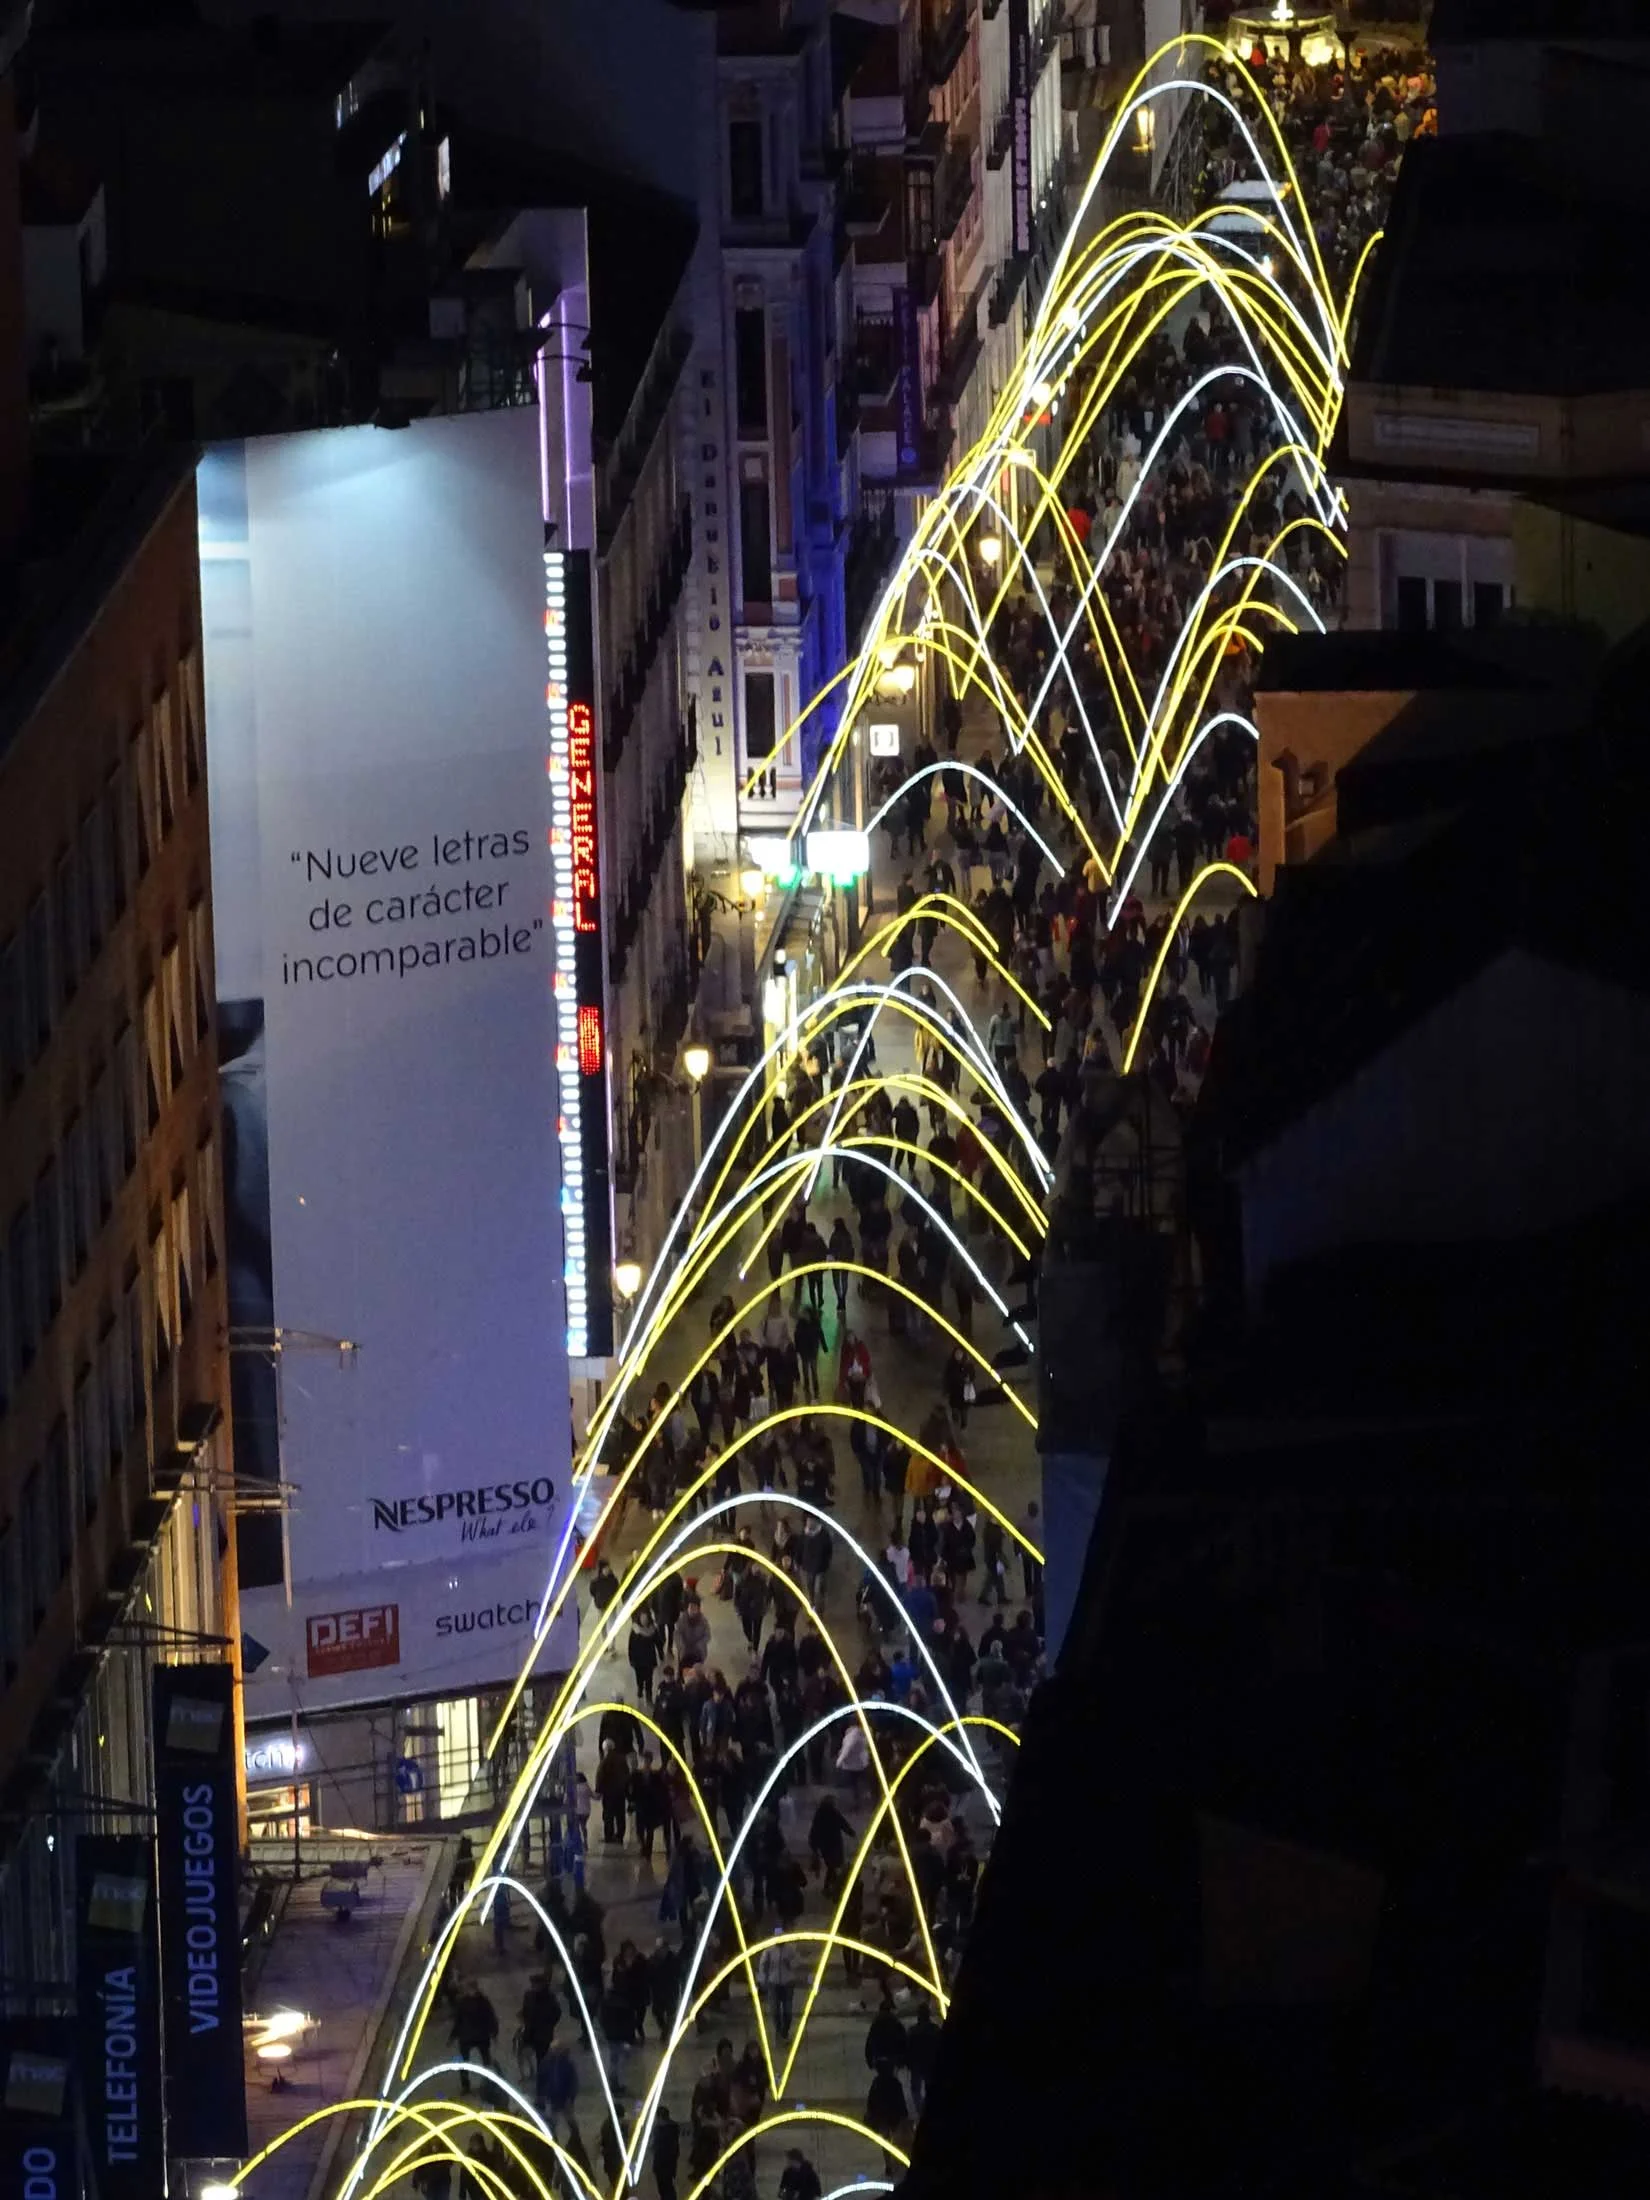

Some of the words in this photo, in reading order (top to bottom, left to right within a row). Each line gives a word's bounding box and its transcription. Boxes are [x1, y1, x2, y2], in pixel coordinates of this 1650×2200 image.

[707, 656, 725, 757] Azul
[569, 703, 598, 931] GENERAL
[290, 844, 420, 882] “Nueve
[433, 829, 531, 867] letras
[308, 898, 353, 931] de
[366, 879, 511, 925] carácter
[371, 1477, 555, 1532] NESPRESSO
[461, 1515, 502, 1543] What
[435, 1598, 543, 1637] swatch
[183, 1783, 220, 2035] VIDEOJUEGOS
[96, 1966, 138, 2166] TELEFONÍA
